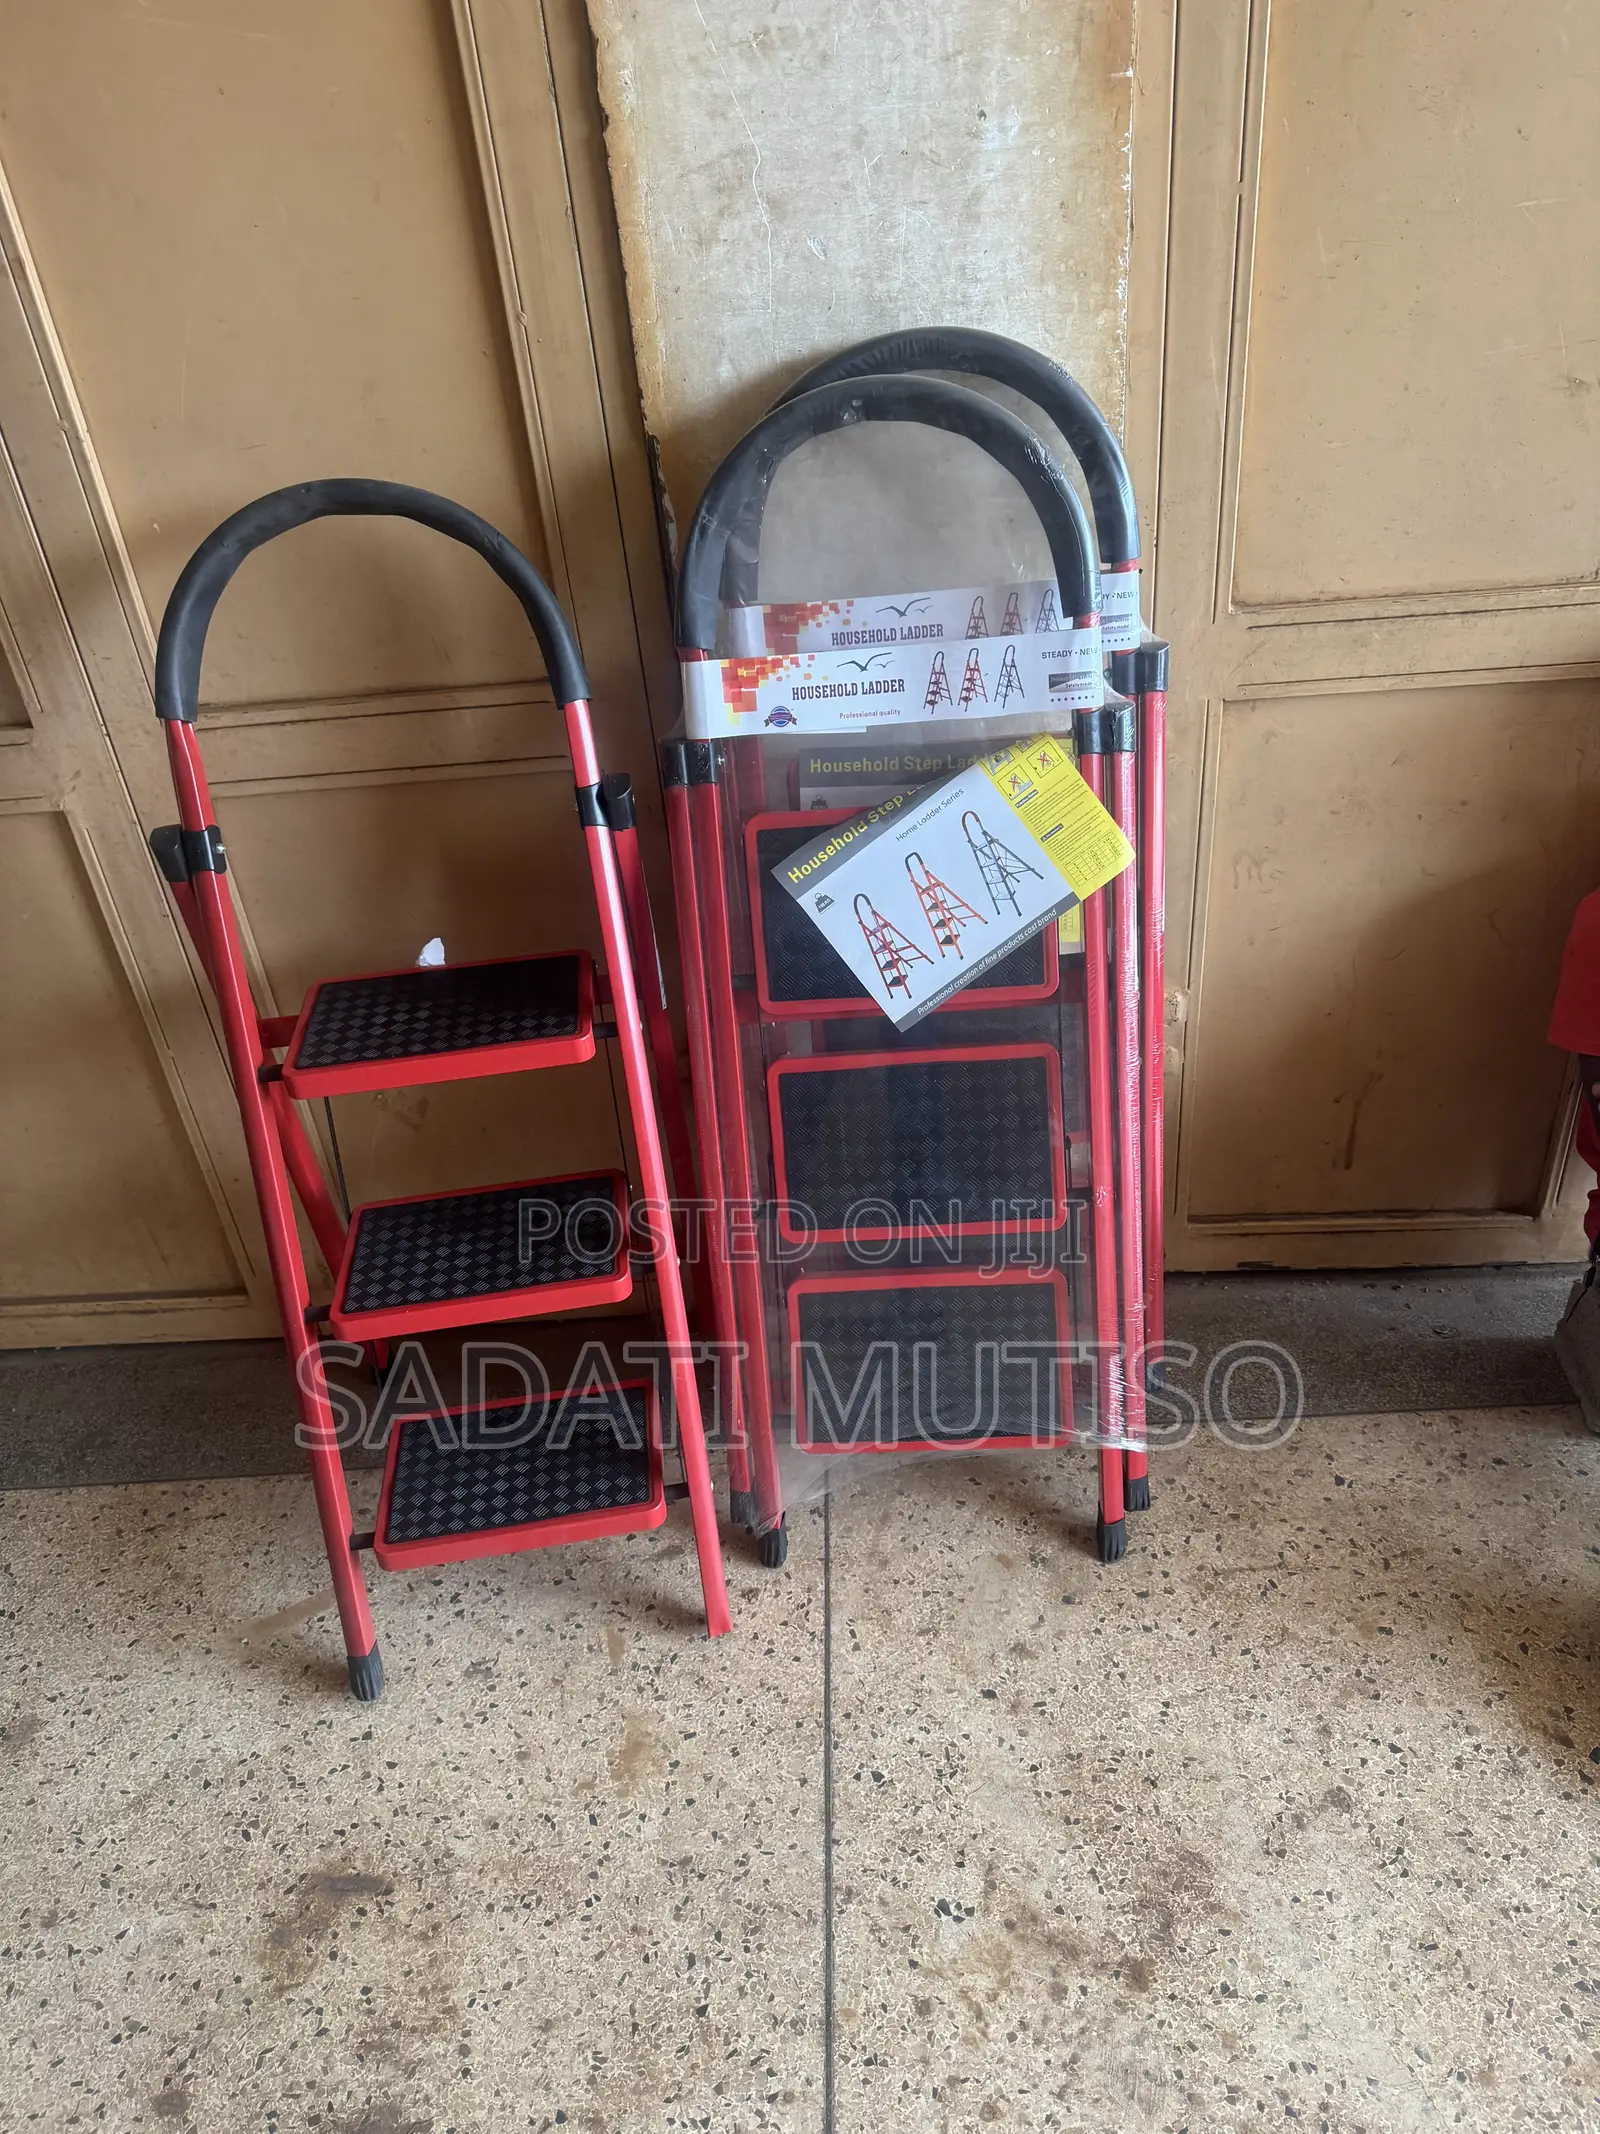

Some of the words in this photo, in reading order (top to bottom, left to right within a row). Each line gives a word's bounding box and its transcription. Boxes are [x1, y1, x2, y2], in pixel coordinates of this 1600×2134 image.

[831, 627, 897, 646] HOUSEHOLD
[900, 624, 944, 640] LADDER
[1041, 649, 1073, 660] STEADY
[792, 680, 857, 701] HOUSEHOLD
[861, 678, 905, 695] LADDER
[839, 710, 878, 719] Professional
[879, 709, 902, 718] quality
[810, 757, 899, 774] Household
[903, 755, 943, 773] Step
[895, 825, 919, 842] Home
[916, 805, 943, 826] Ladder
[940, 788, 965, 808] Series
[787, 820, 869, 884] Household
[867, 794, 904, 823] Step
[917, 983, 954, 1015] Professional
[953, 967, 979, 989] creation
[978, 961, 986, 970] of
[997, 934, 1025, 958] products
[1037, 907, 1057, 927] brand
